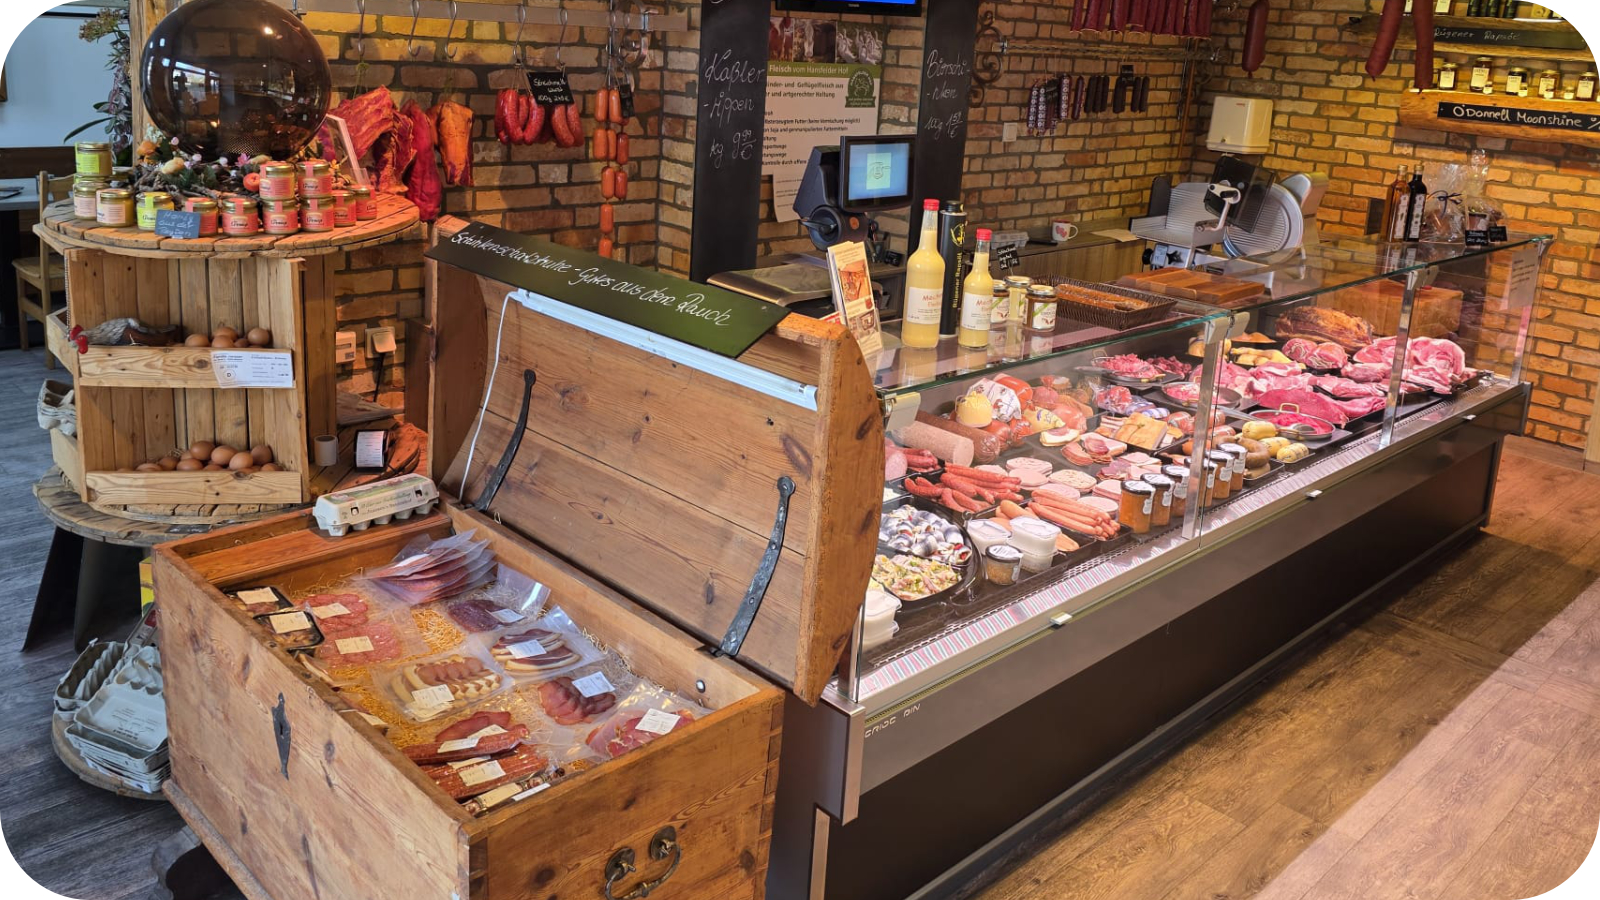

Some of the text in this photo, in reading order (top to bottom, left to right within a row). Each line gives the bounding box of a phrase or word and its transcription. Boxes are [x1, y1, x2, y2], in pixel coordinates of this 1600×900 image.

[769, 64, 792, 73] Fleisch
[838, 66, 849, 74] Hof
[1516, 113, 1583, 127] Moonshine
[611, 281, 646, 296] aus
[638, 286, 677, 306] dem
[676, 293, 733, 326] Rauch
